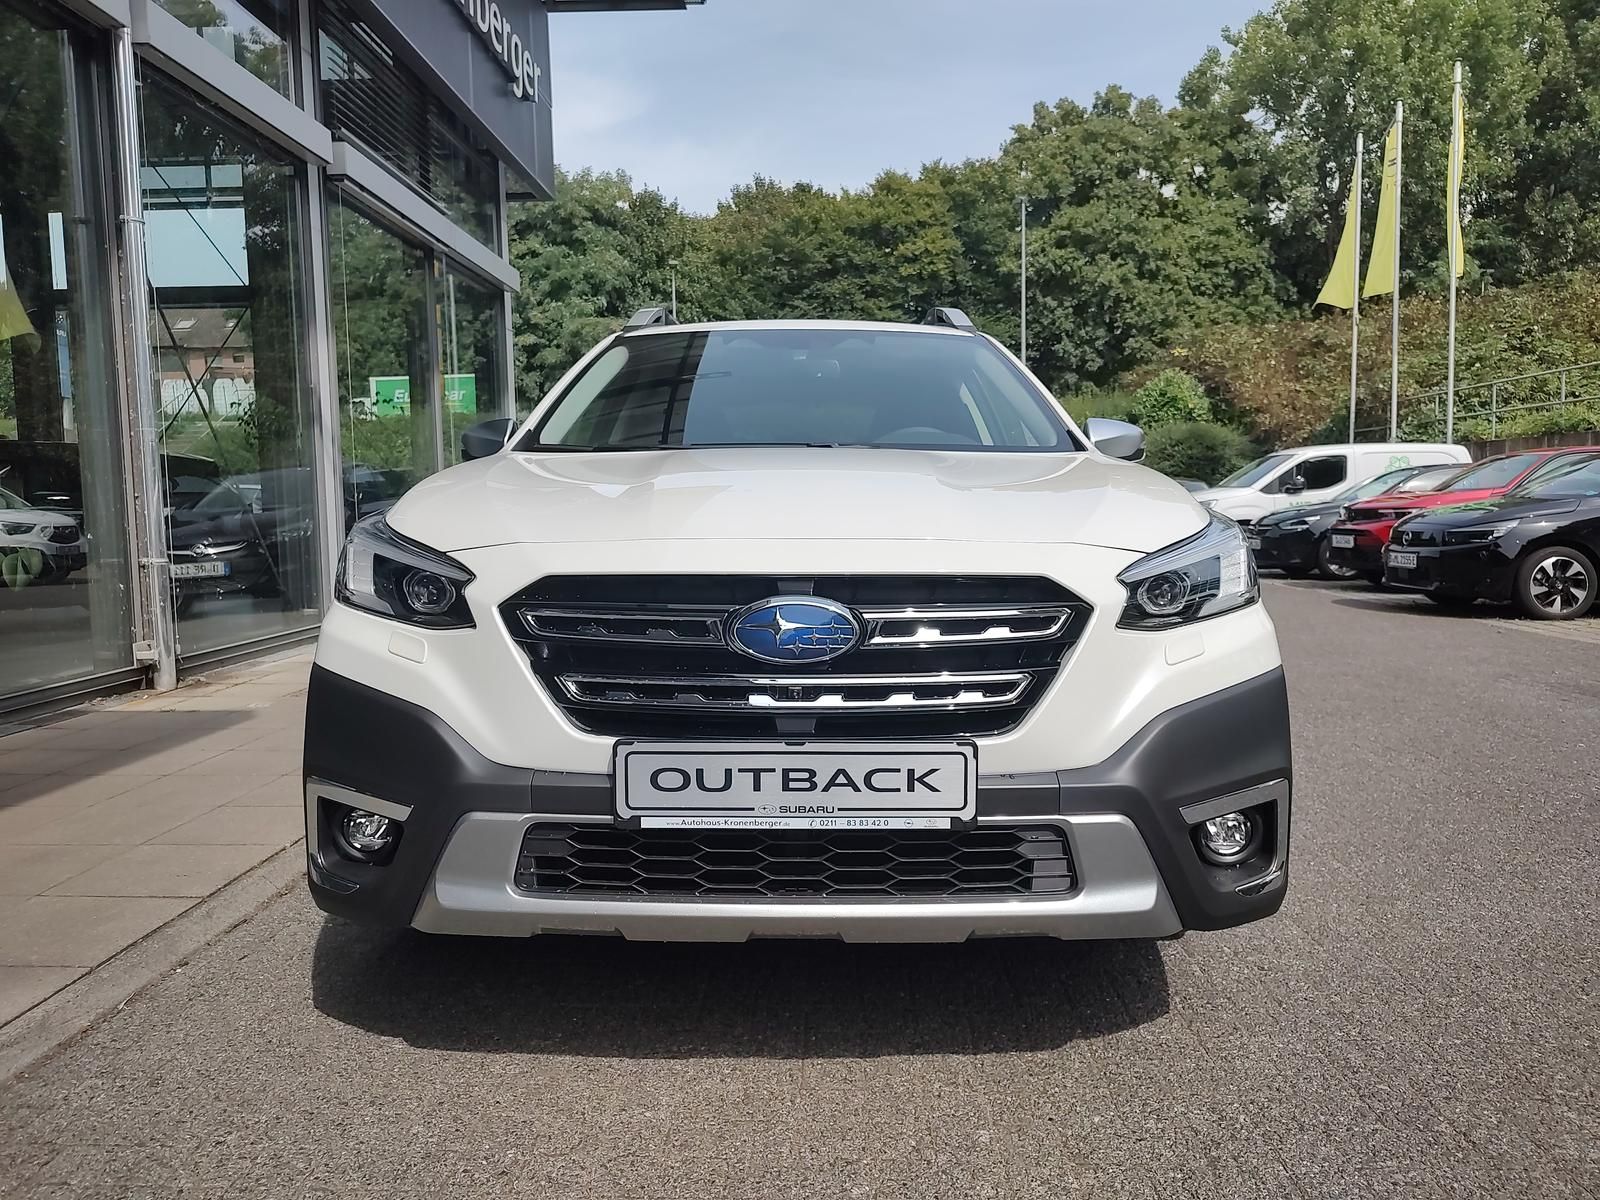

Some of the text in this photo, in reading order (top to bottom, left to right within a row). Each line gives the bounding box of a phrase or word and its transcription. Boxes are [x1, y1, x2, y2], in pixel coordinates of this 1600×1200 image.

[458, 0, 542, 104] erger
[649, 767, 942, 793] OUTBACK
[778, 805, 835, 814] SUBARU
[820, 819, 837, 827] 0211
[847, 819, 857, 827] 83
[859, 819, 869, 827] 83
[871, 819, 881, 827] 42
[883, 819, 889, 827] 0
